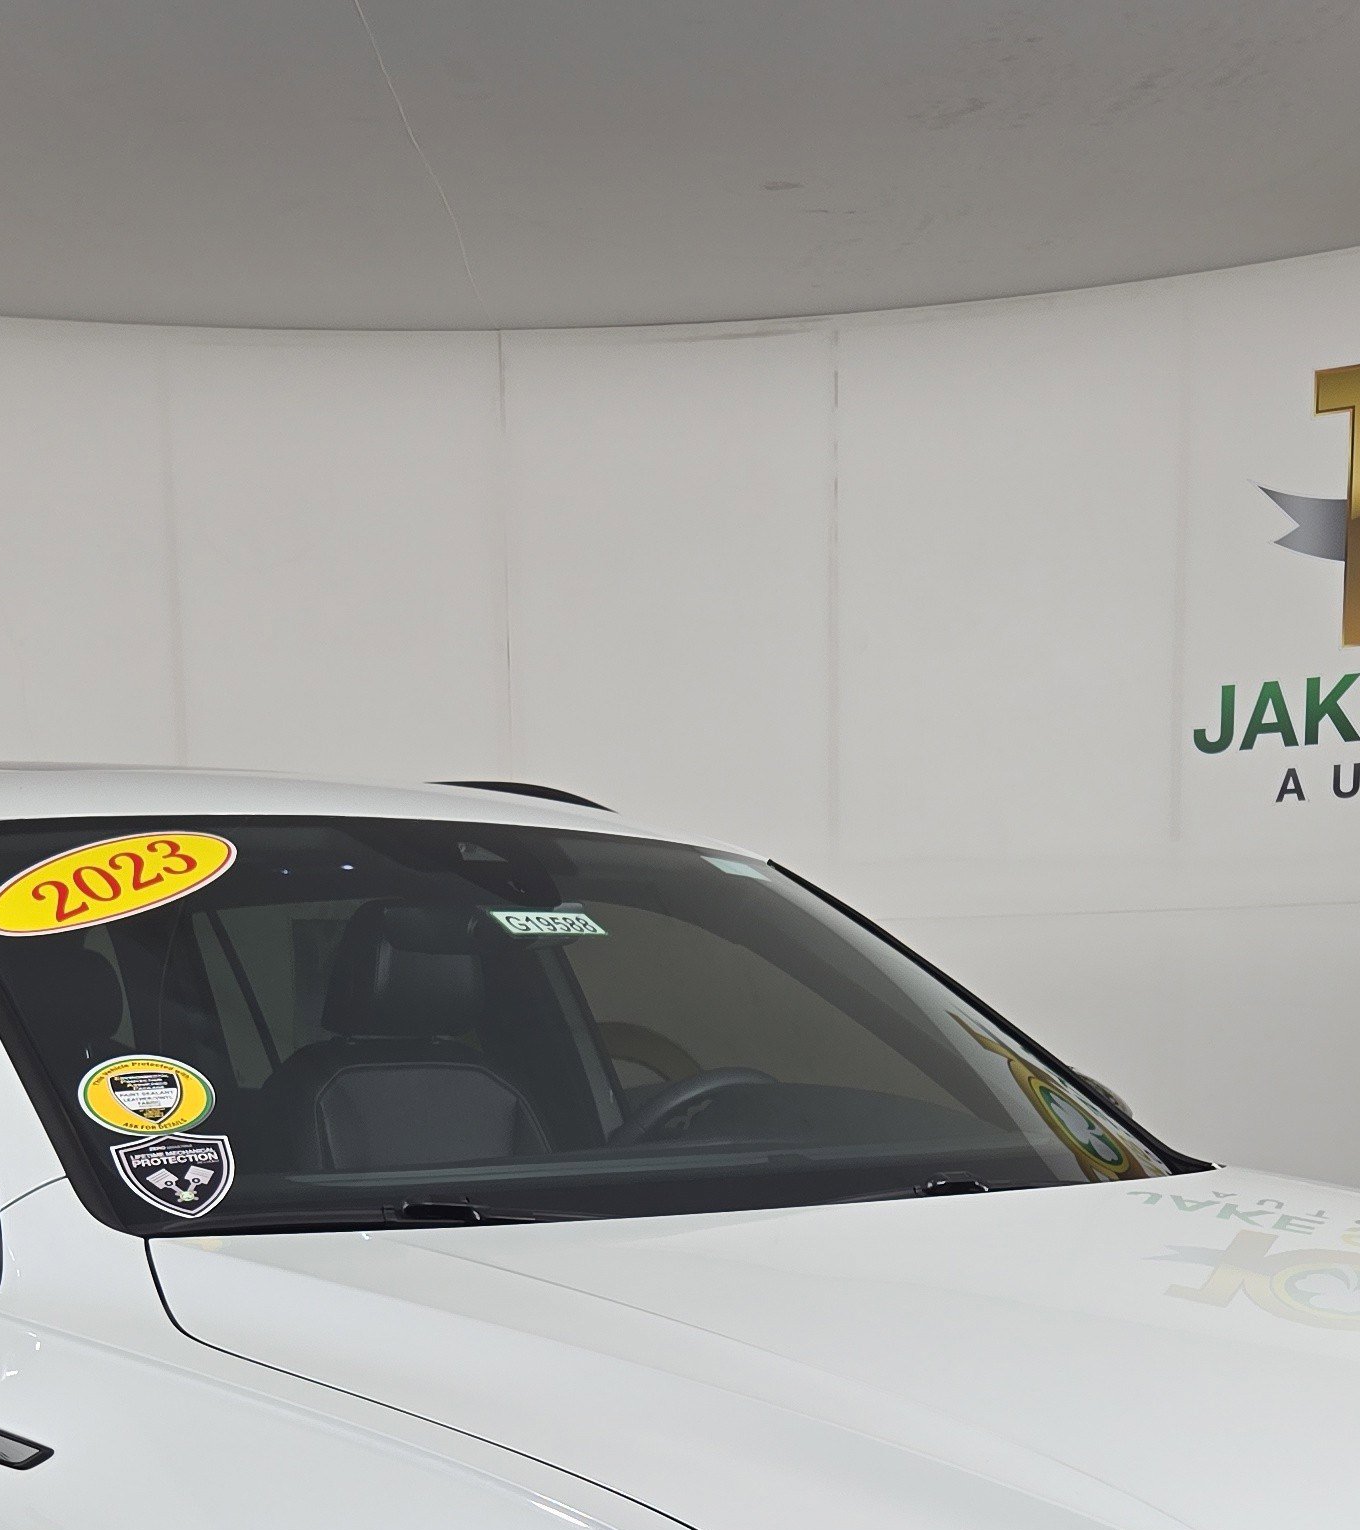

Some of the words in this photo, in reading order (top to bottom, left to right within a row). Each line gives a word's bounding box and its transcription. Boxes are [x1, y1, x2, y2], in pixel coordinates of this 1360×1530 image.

[31, 839, 198, 922] 2023
[505, 915, 598, 933] G19588
[131, 1061, 174, 1071] Protected
[131, 1152, 219, 1168] PROTECTION
